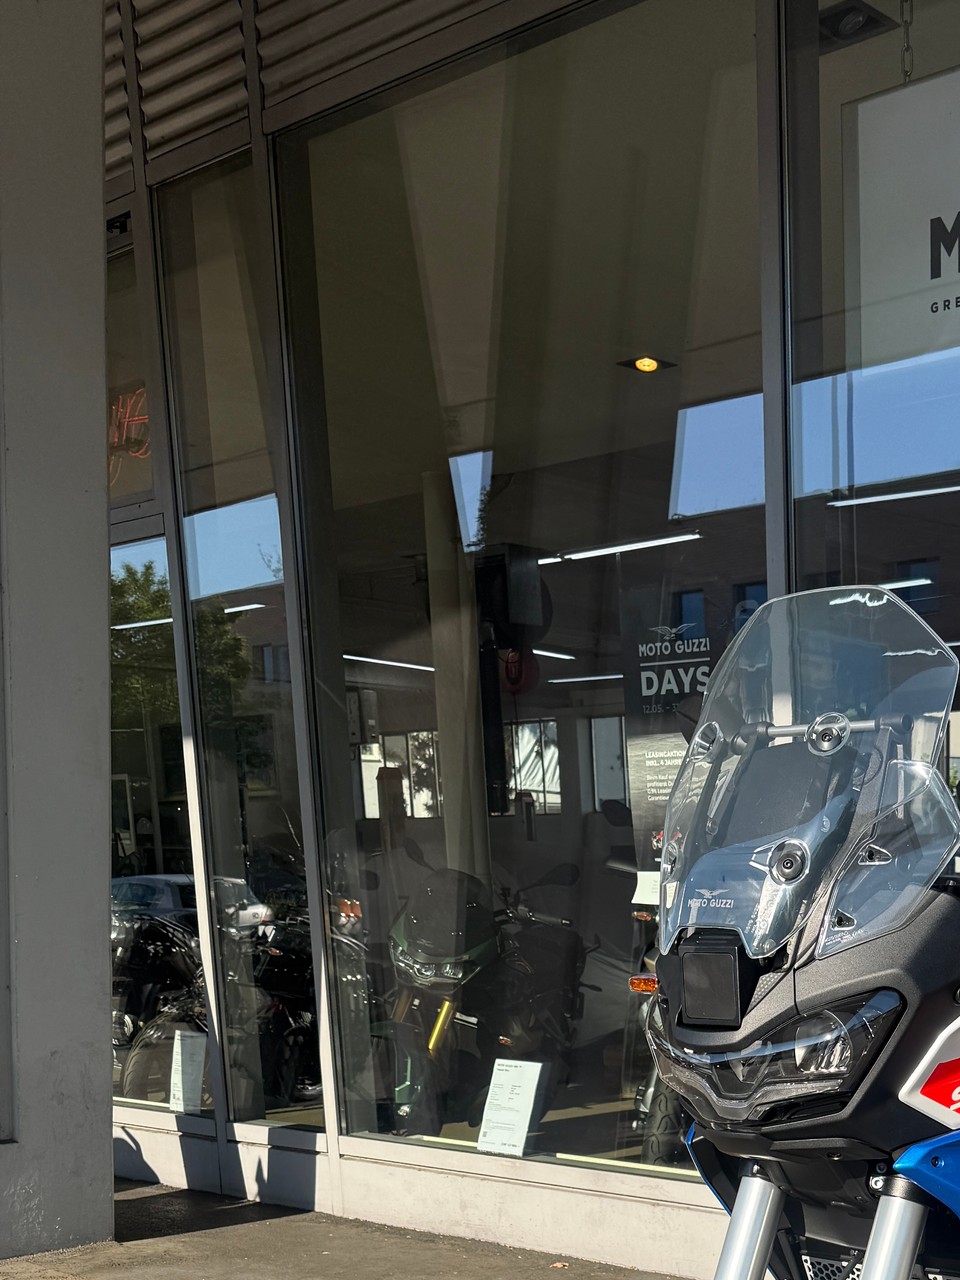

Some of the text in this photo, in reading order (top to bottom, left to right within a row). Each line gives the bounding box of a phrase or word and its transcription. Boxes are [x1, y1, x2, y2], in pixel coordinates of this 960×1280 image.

[638, 638, 711, 657] MOTO GUZZI
[640, 666, 710, 697] DAYS
[710, 899, 734, 908] GUZZI
